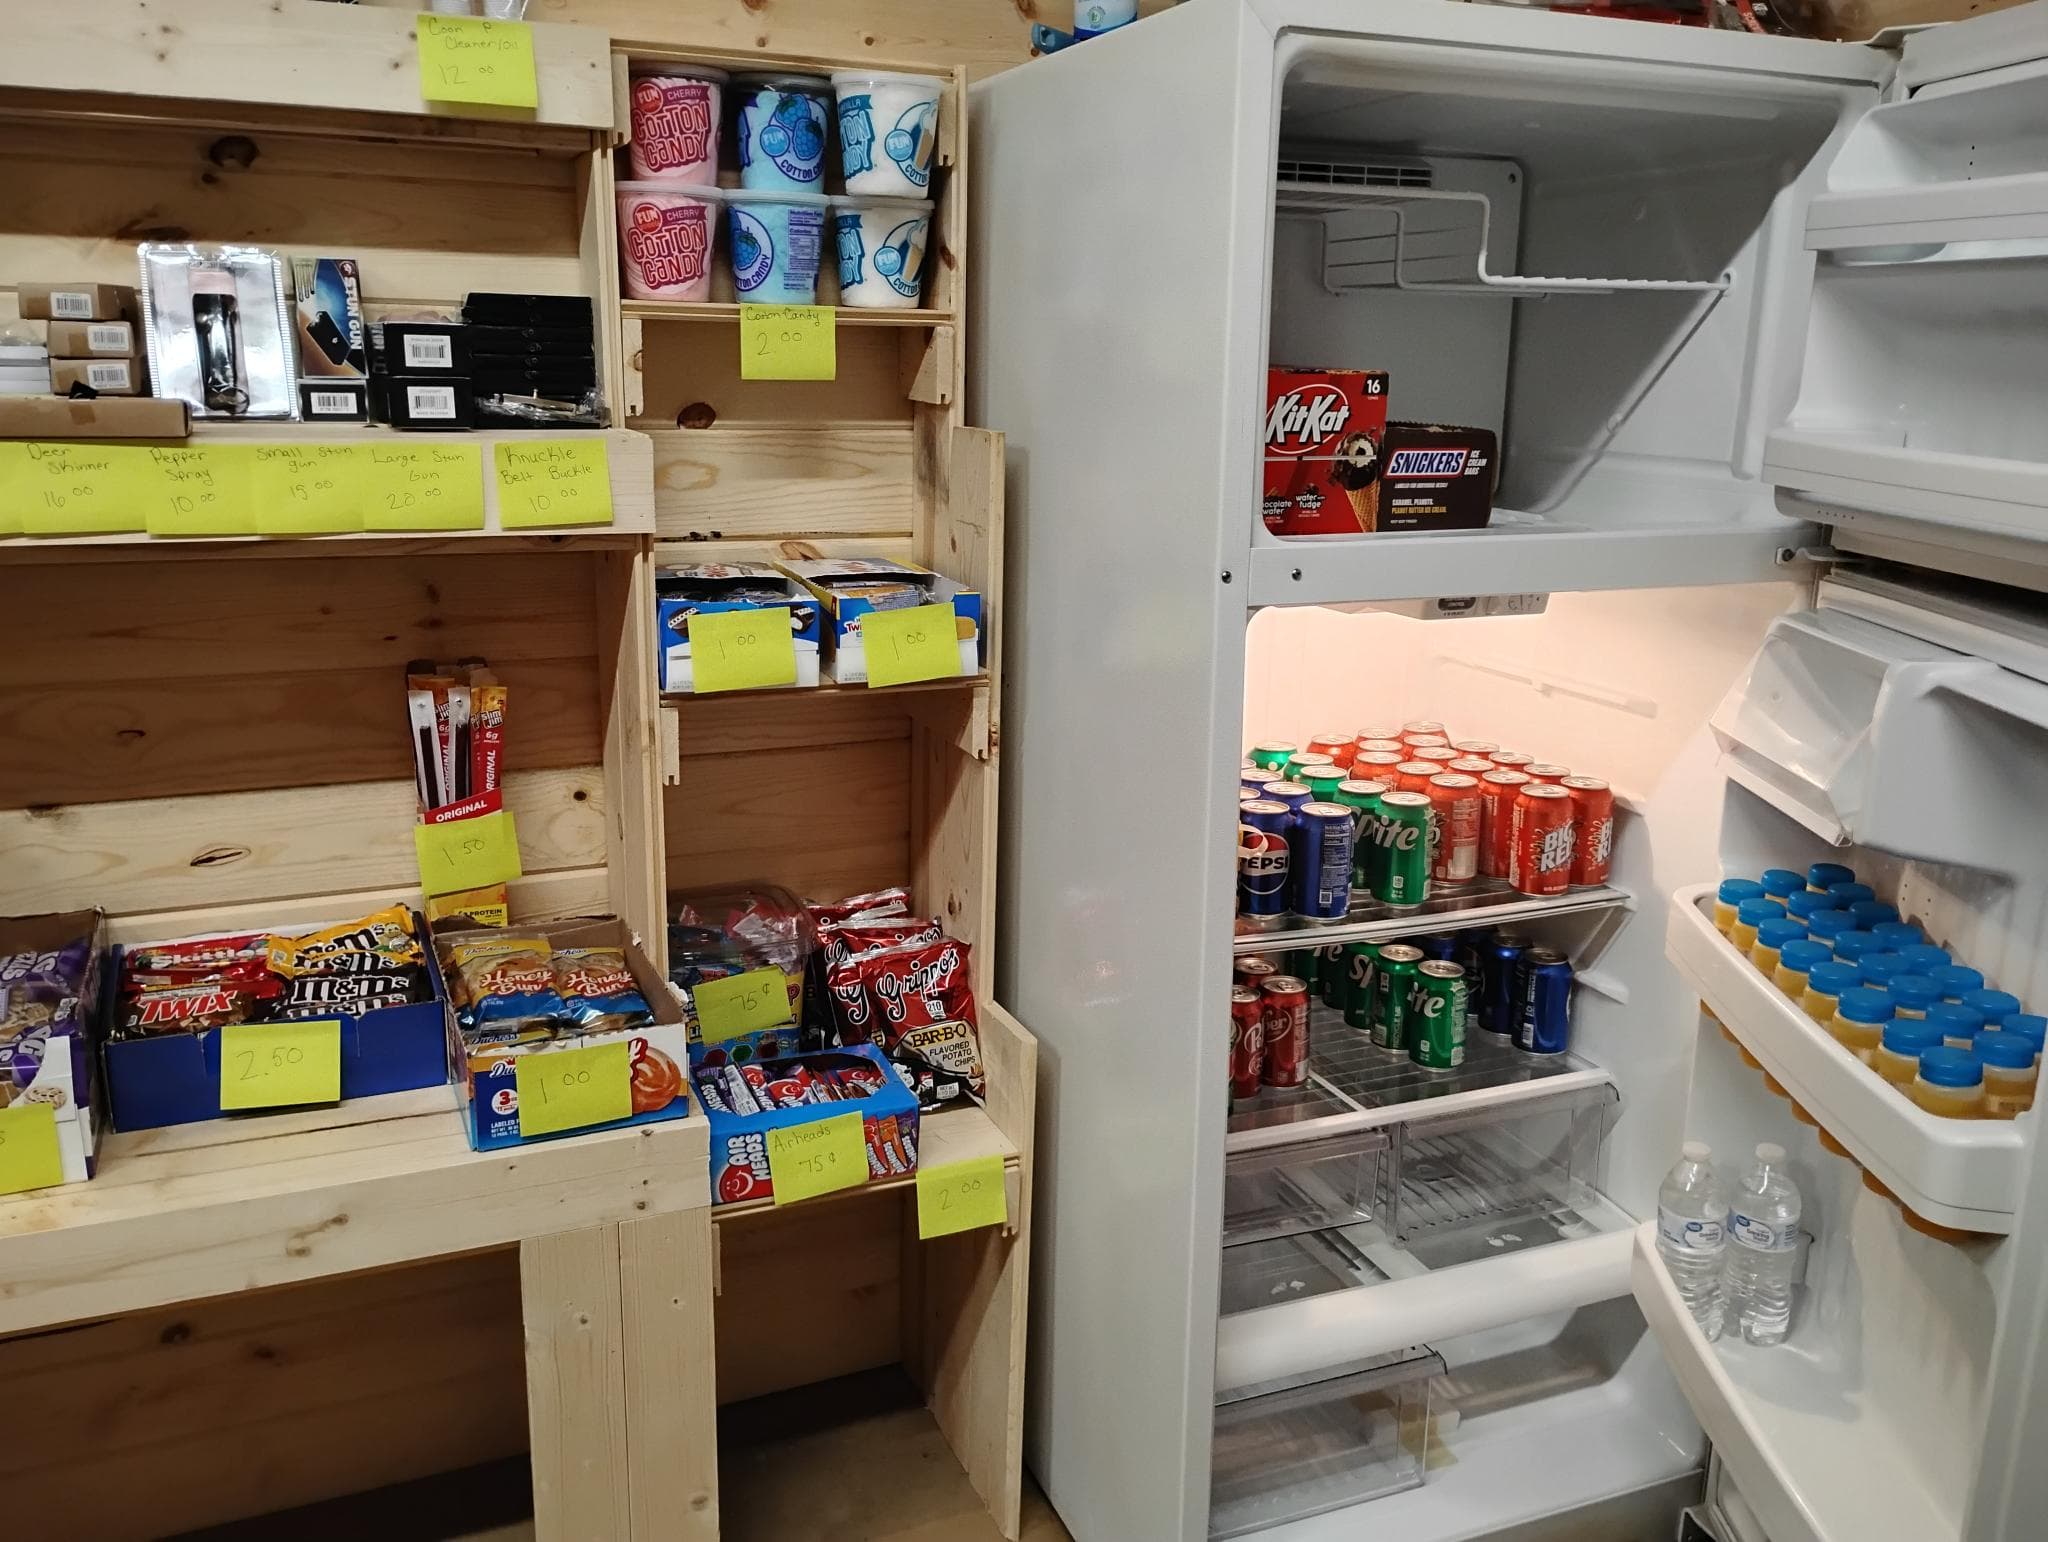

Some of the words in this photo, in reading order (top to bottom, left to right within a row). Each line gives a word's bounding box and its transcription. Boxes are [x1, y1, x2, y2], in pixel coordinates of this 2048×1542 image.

[638, 89, 659, 104] FUN
[667, 88, 702, 100] CHERRY
[633, 101, 710, 142] COTTON
[763, 132, 785, 146] FUN
[644, 132, 707, 169] CANDY
[636, 209, 658, 224] FUN
[667, 208, 700, 221] CHERRY
[628, 221, 707, 262] COTTON
[643, 252, 704, 290] CANDY
[348, 319, 363, 350] GUN
[1366, 379, 1381, 395] 16
[27, 443, 71, 461] Deer
[149, 447, 208, 465] Pepper
[372, 450, 420, 468] Large
[432, 451, 465, 463] Stun
[505, 445, 577, 467] Knuckle
[1470, 450, 1481, 458] ICE
[1390, 452, 1464, 474] SNICKERS
[1467, 458, 1488, 467] CREAM
[165, 468, 216, 487] Spray
[501, 469, 534, 485] Belt
[548, 464, 593, 480] Buckle
[1263, 500, 1293, 508] ocolate
[1295, 493, 1318, 501] wafer
[1299, 501, 1322, 509] fudge
[485, 730, 499, 741] 6g
[486, 749, 496, 792] RIGINAL
[436, 799, 488, 822] ORIGINAL
[481, 969, 553, 988] Honey
[567, 970, 633, 988] Honey
[490, 982, 542, 996] Bun
[576, 981, 625, 997] Bun
[137, 990, 238, 1025] TWIX
[911, 1023, 967, 1048] BAR-B-Q
[929, 1040, 970, 1056] FLAVORED
[942, 1048, 972, 1062] POTATO
[954, 1055, 976, 1068] CHIPS
[499, 1090, 511, 1106] 3
[774, 1125, 831, 1152] Airheads
[726, 1134, 750, 1167] AIR
[745, 1133, 772, 1180] HEADS
